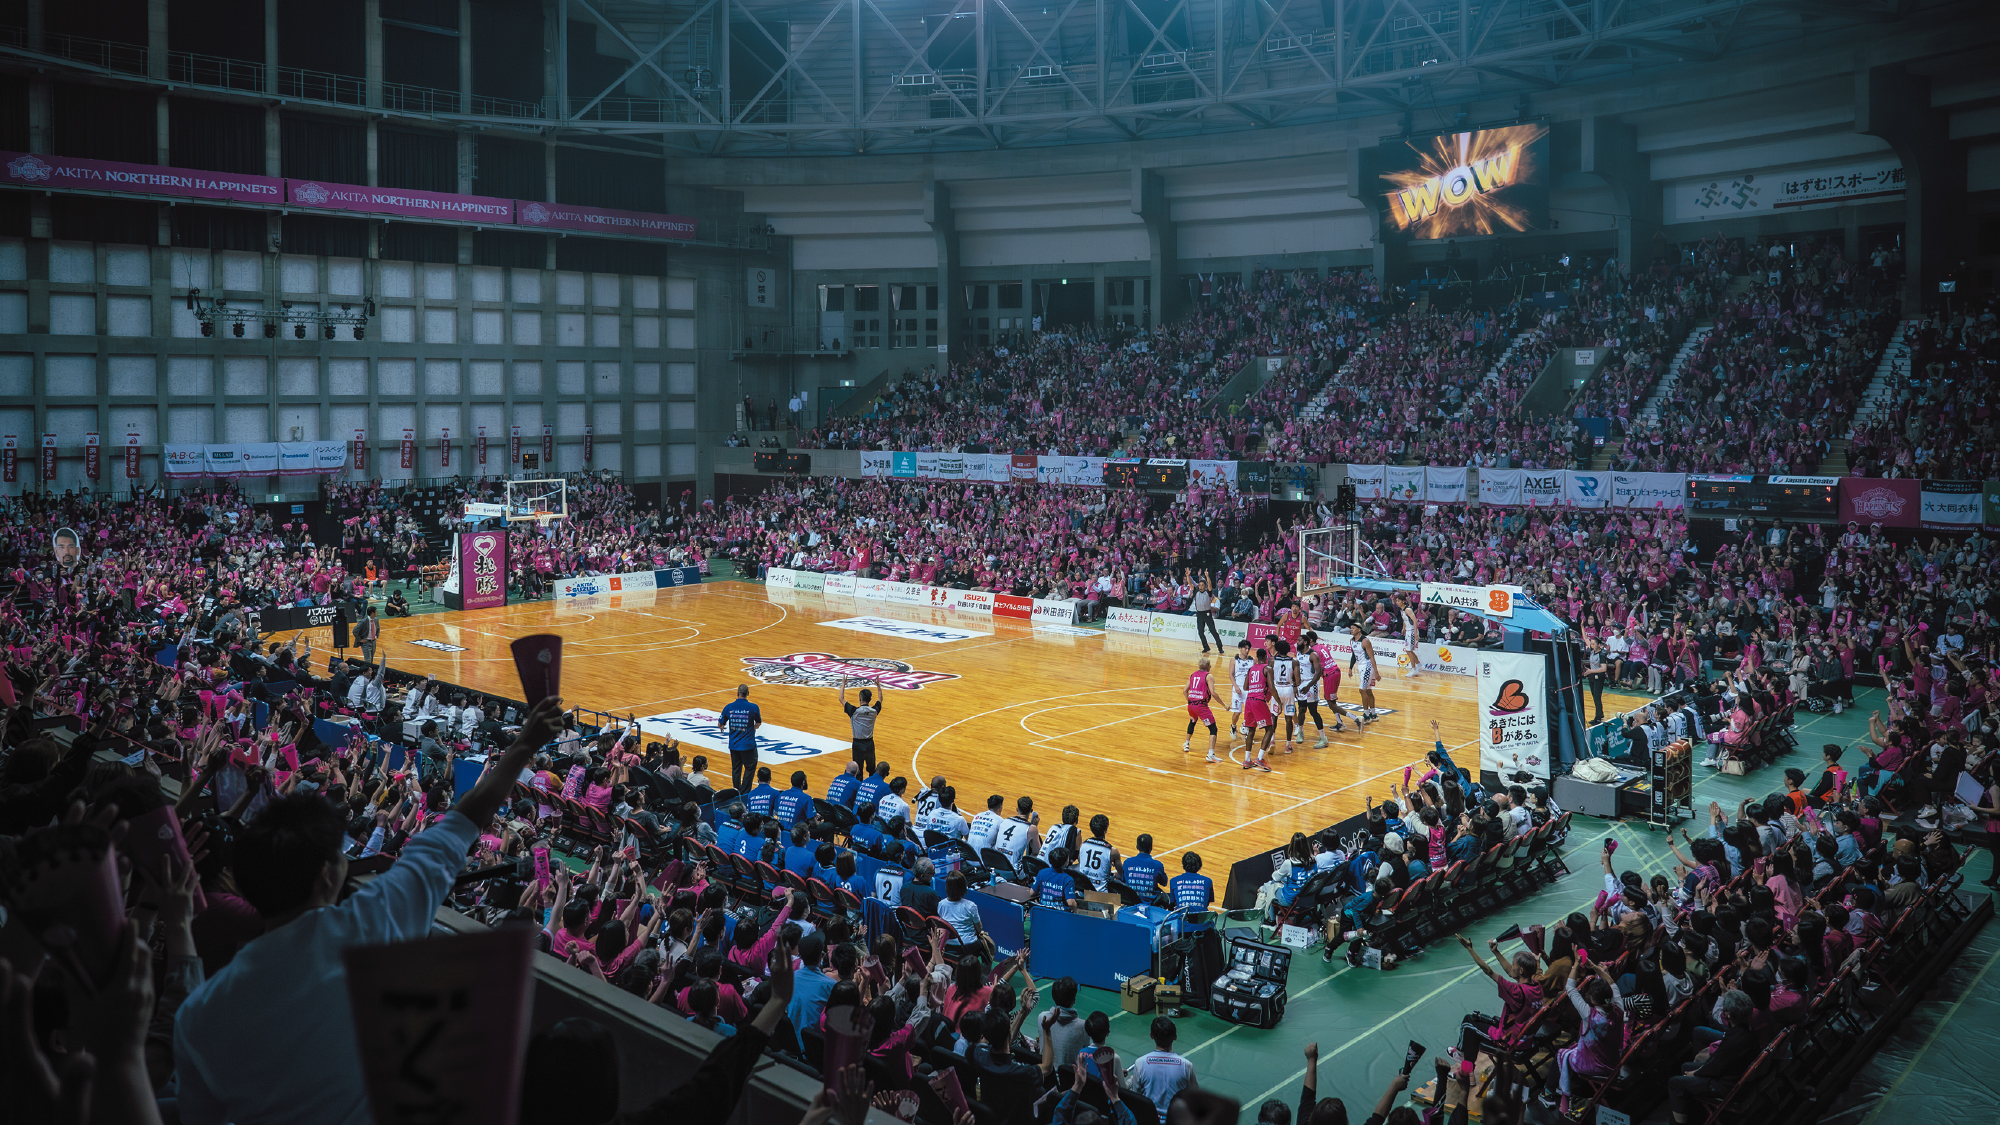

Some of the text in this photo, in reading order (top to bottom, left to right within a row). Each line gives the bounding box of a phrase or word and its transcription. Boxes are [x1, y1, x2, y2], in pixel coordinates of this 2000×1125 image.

[54, 166, 278, 195] AKITA NORTHERN HAPPINETS
[1397, 148, 1512, 224] WOW
[331, 190, 508, 216] AKITA NORTHERN HAPPINETS
[551, 211, 695, 232] AKITA NORTHERN HAPPINETS
[757, 285, 766, 304] 禁煙
[873, 459, 892, 469] 秋田県
[1523, 476, 1561, 489] AXEL
[1853, 500, 1903, 515] HAPPINETS
[1936, 503, 1979, 514] 大同衣料
[964, 593, 988, 602] ISUZU
[1446, 595, 1479, 607] JA共済
[1043, 606, 1073, 619] 秋田銀行
[1118, 612, 1148, 624] あきたこまち
[1250, 670, 1260, 683] 30
[1280, 664, 1287, 677] 2
[1439, 664, 1467, 675] 秋田テレビ
[1192, 676, 1201, 689] 17
[1489, 713, 1536, 730] あきたには
[1491, 727, 1538, 745] Bがある。
[917, 798, 936, 817] 28
[1003, 824, 1017, 842] 4
[1044, 829, 1058, 844] 5
[739, 839, 747, 855] 3
[1084, 848, 1103, 870] 15
[882, 879, 892, 901] 2
